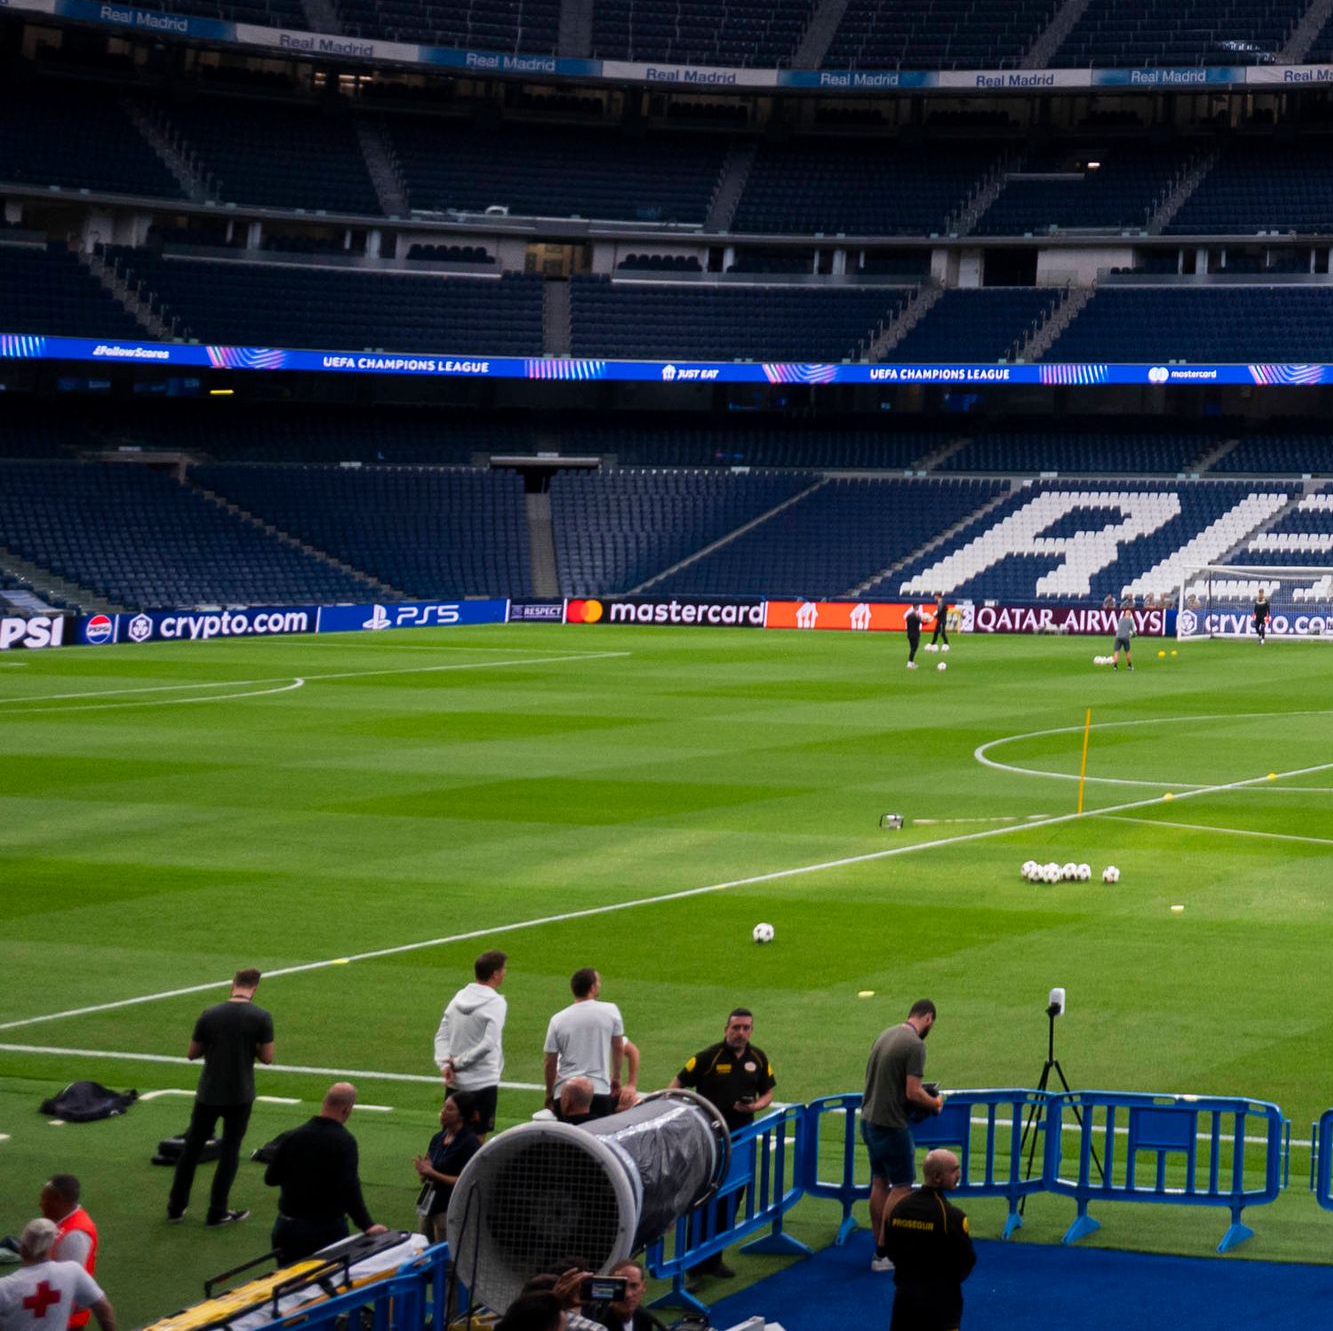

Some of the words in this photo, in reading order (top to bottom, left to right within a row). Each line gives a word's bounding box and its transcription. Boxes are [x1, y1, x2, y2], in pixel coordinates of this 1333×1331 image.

[101, 7, 132, 23] Real
[137, 13, 188, 31] Madrid
[280, 34, 314, 49] Real
[320, 38, 373, 58] Madrid
[467, 54, 499, 67] Real
[503, 56, 555, 71] Madrid
[646, 68, 679, 81] Real
[684, 70, 736, 84] Madrid
[820, 73, 850, 85] Real
[854, 73, 898, 86] Madrid
[976, 75, 1005, 87] Real
[1009, 74, 1054, 86] Madrid
[1131, 71, 1159, 82] Real
[1162, 71, 1206, 82] Madrid
[1284, 70, 1313, 82] Real
[323, 357, 355, 369] UEFA
[358, 358, 435, 372] CHAMPIONS
[439, 361, 490, 373] LEAGUE
[677, 369, 700, 380] JUST
[701, 369, 719, 378] EAT
[871, 369, 897, 379] UEFA
[900, 369, 965, 379] CHAMPIONS
[968, 369, 1009, 379] LEAGUE
[1171, 370, 1217, 379] mastercard
[397, 605, 459, 624] PS5
[524, 606, 562, 617] RESPECT
[610, 600, 764, 624] mastercard
[160, 611, 308, 641] crypto.com
[977, 608, 1064, 633] QATAR
[1065, 609, 1162, 633] AIRWYS
[0, 615, 64, 649] PSI
